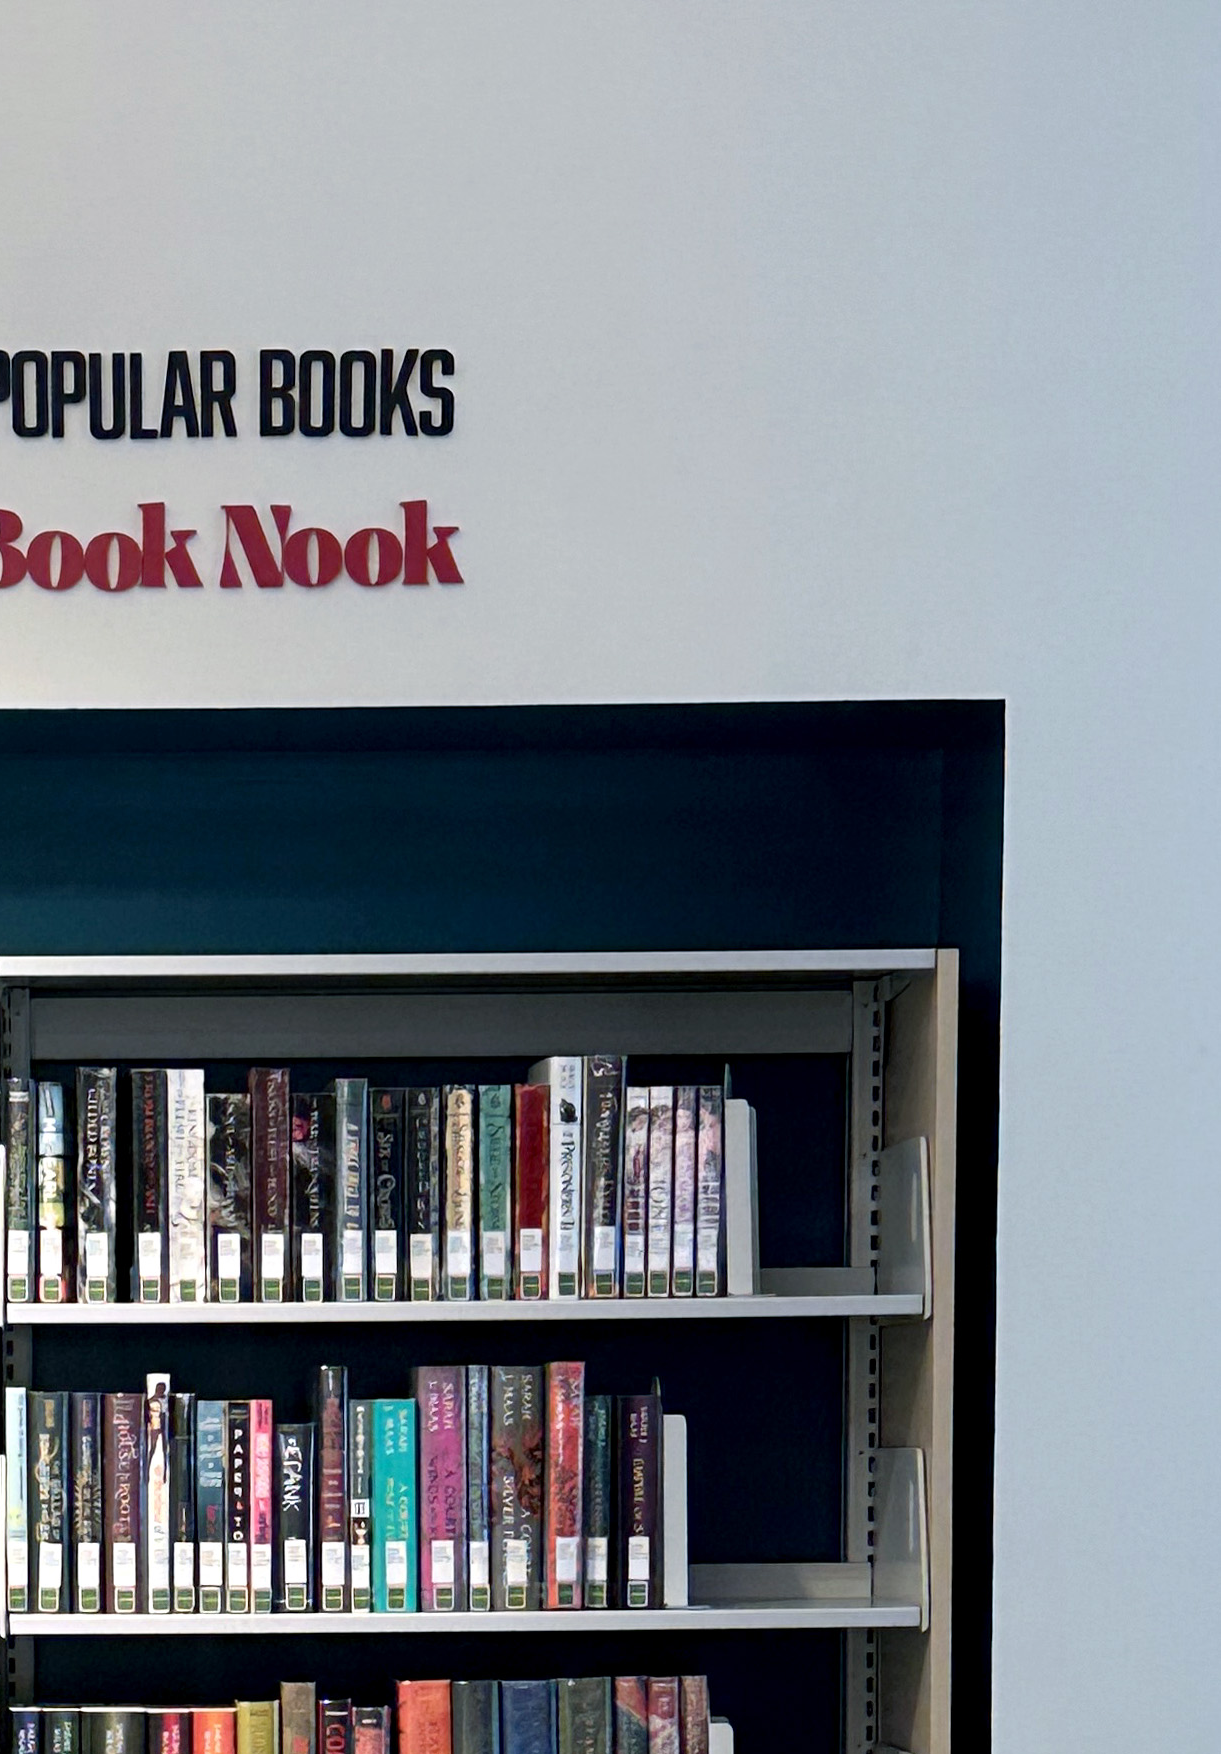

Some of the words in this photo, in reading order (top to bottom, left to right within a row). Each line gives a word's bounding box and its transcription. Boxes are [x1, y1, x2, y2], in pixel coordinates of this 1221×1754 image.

[259, 349, 456, 438] BOOKS
[220, 500, 465, 590] Nook
[443, 1382, 454, 1429] SARAH
